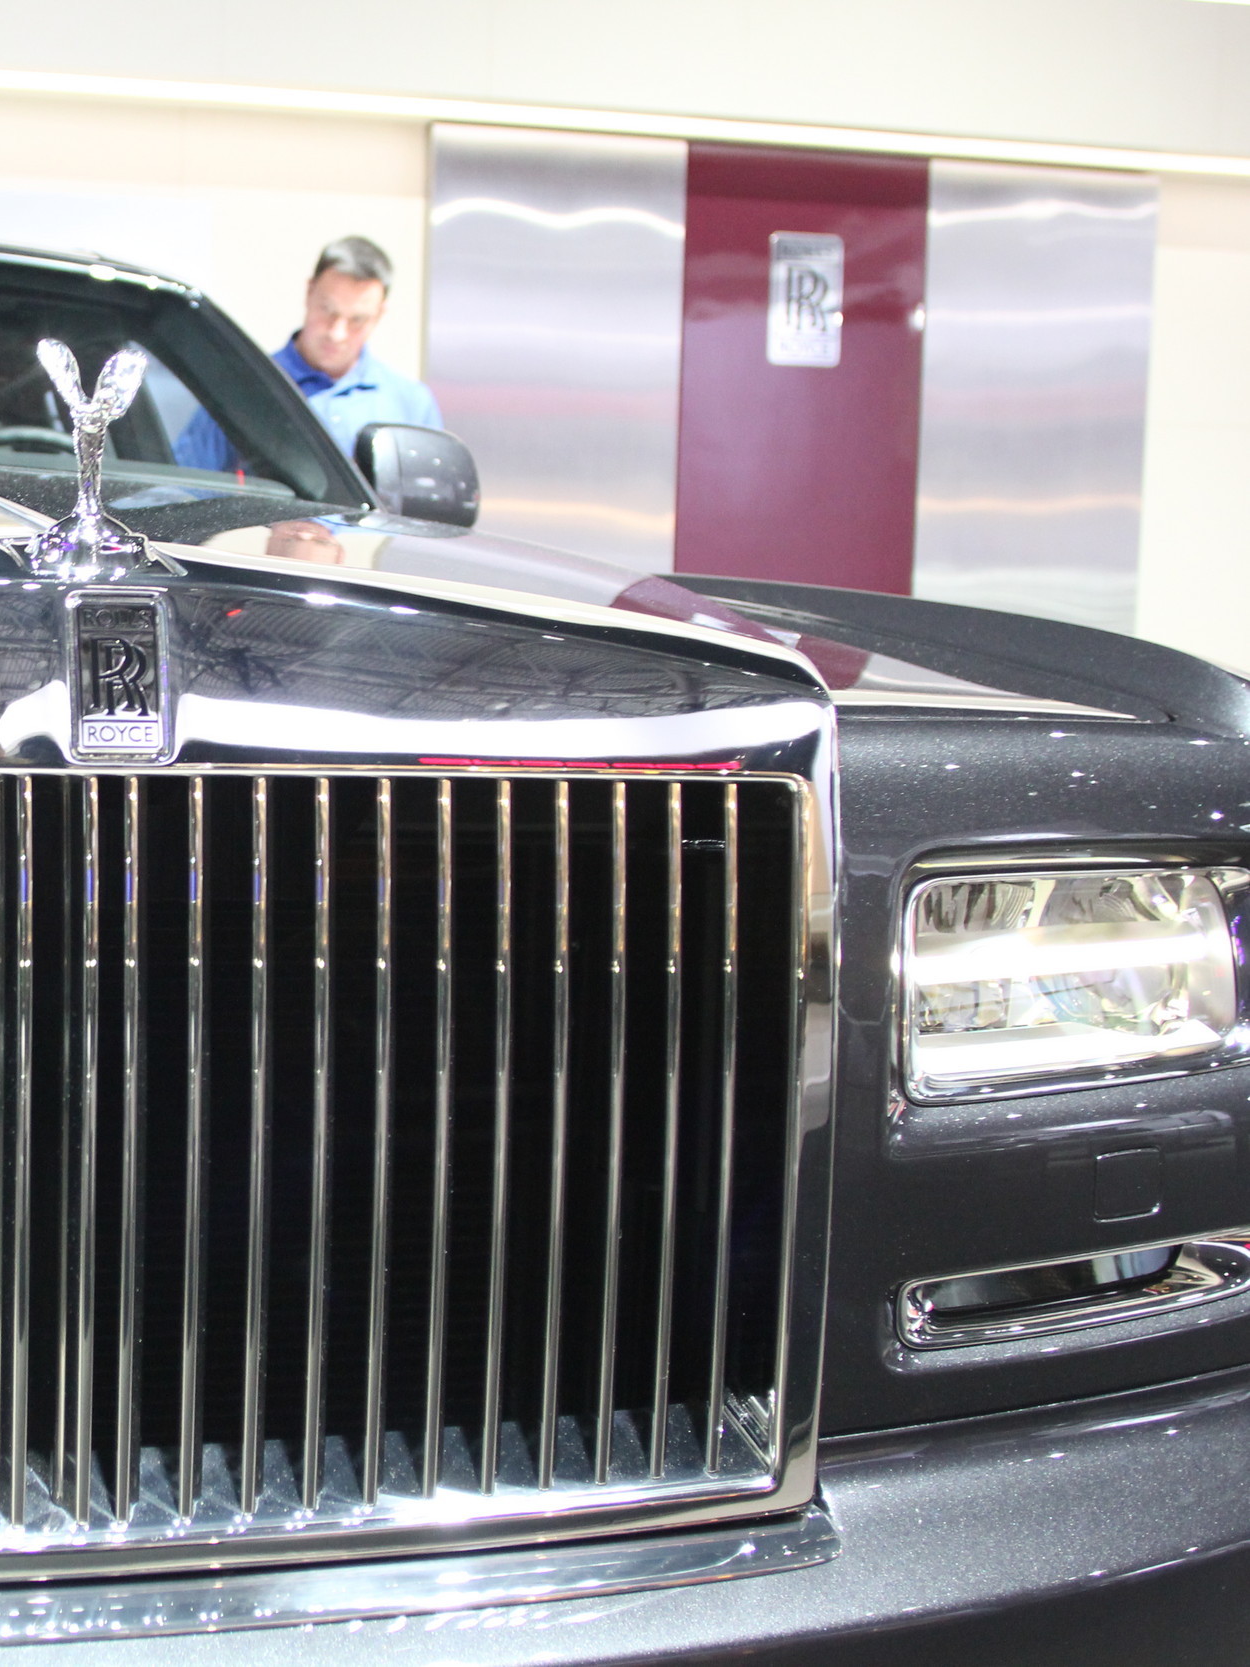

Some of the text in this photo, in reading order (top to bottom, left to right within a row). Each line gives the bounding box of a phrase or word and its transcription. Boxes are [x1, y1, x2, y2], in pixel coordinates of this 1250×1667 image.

[787, 266, 828, 332] RR
[91, 637, 150, 716] RR
[88, 725, 153, 742] ROYCE
